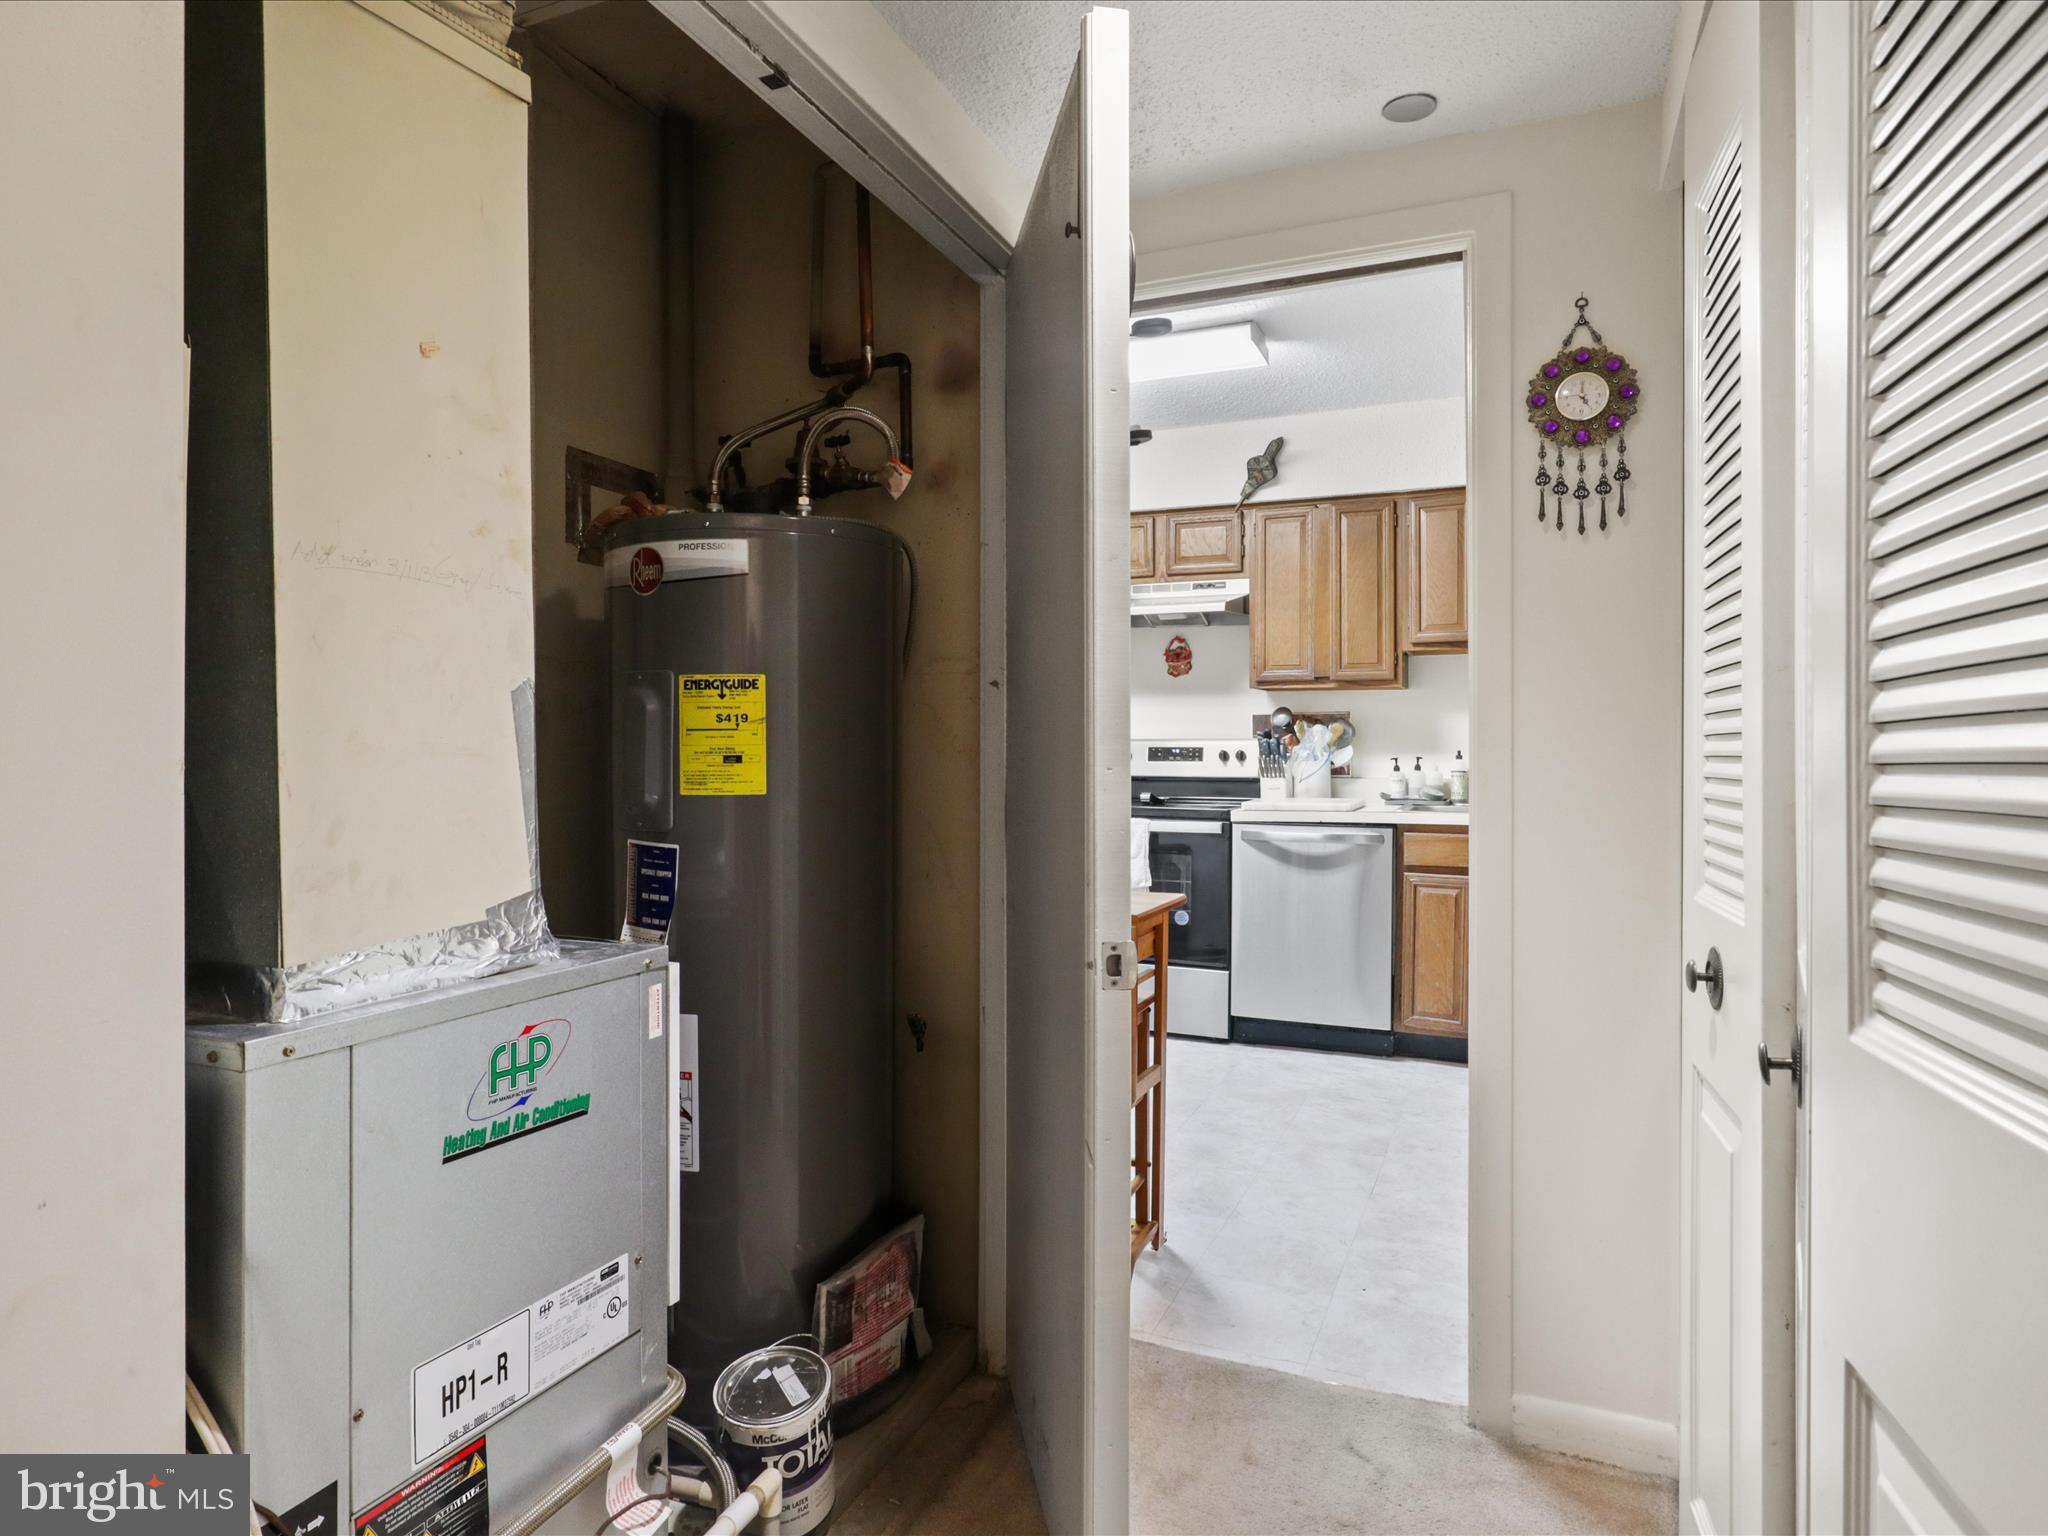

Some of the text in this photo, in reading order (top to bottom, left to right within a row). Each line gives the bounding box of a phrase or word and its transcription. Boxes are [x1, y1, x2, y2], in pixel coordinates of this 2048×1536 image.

[678, 542, 728, 551] PROFESSIO
[632, 549, 661, 587] Rheem
[683, 678, 760, 692] ENERGYGUIDE
[715, 713, 749, 723] $419
[488, 1033, 553, 1097] FHP
[499, 1086, 538, 1102] MANUFACTURING
[442, 1093, 591, 1156] Heating And Air Conditioning
